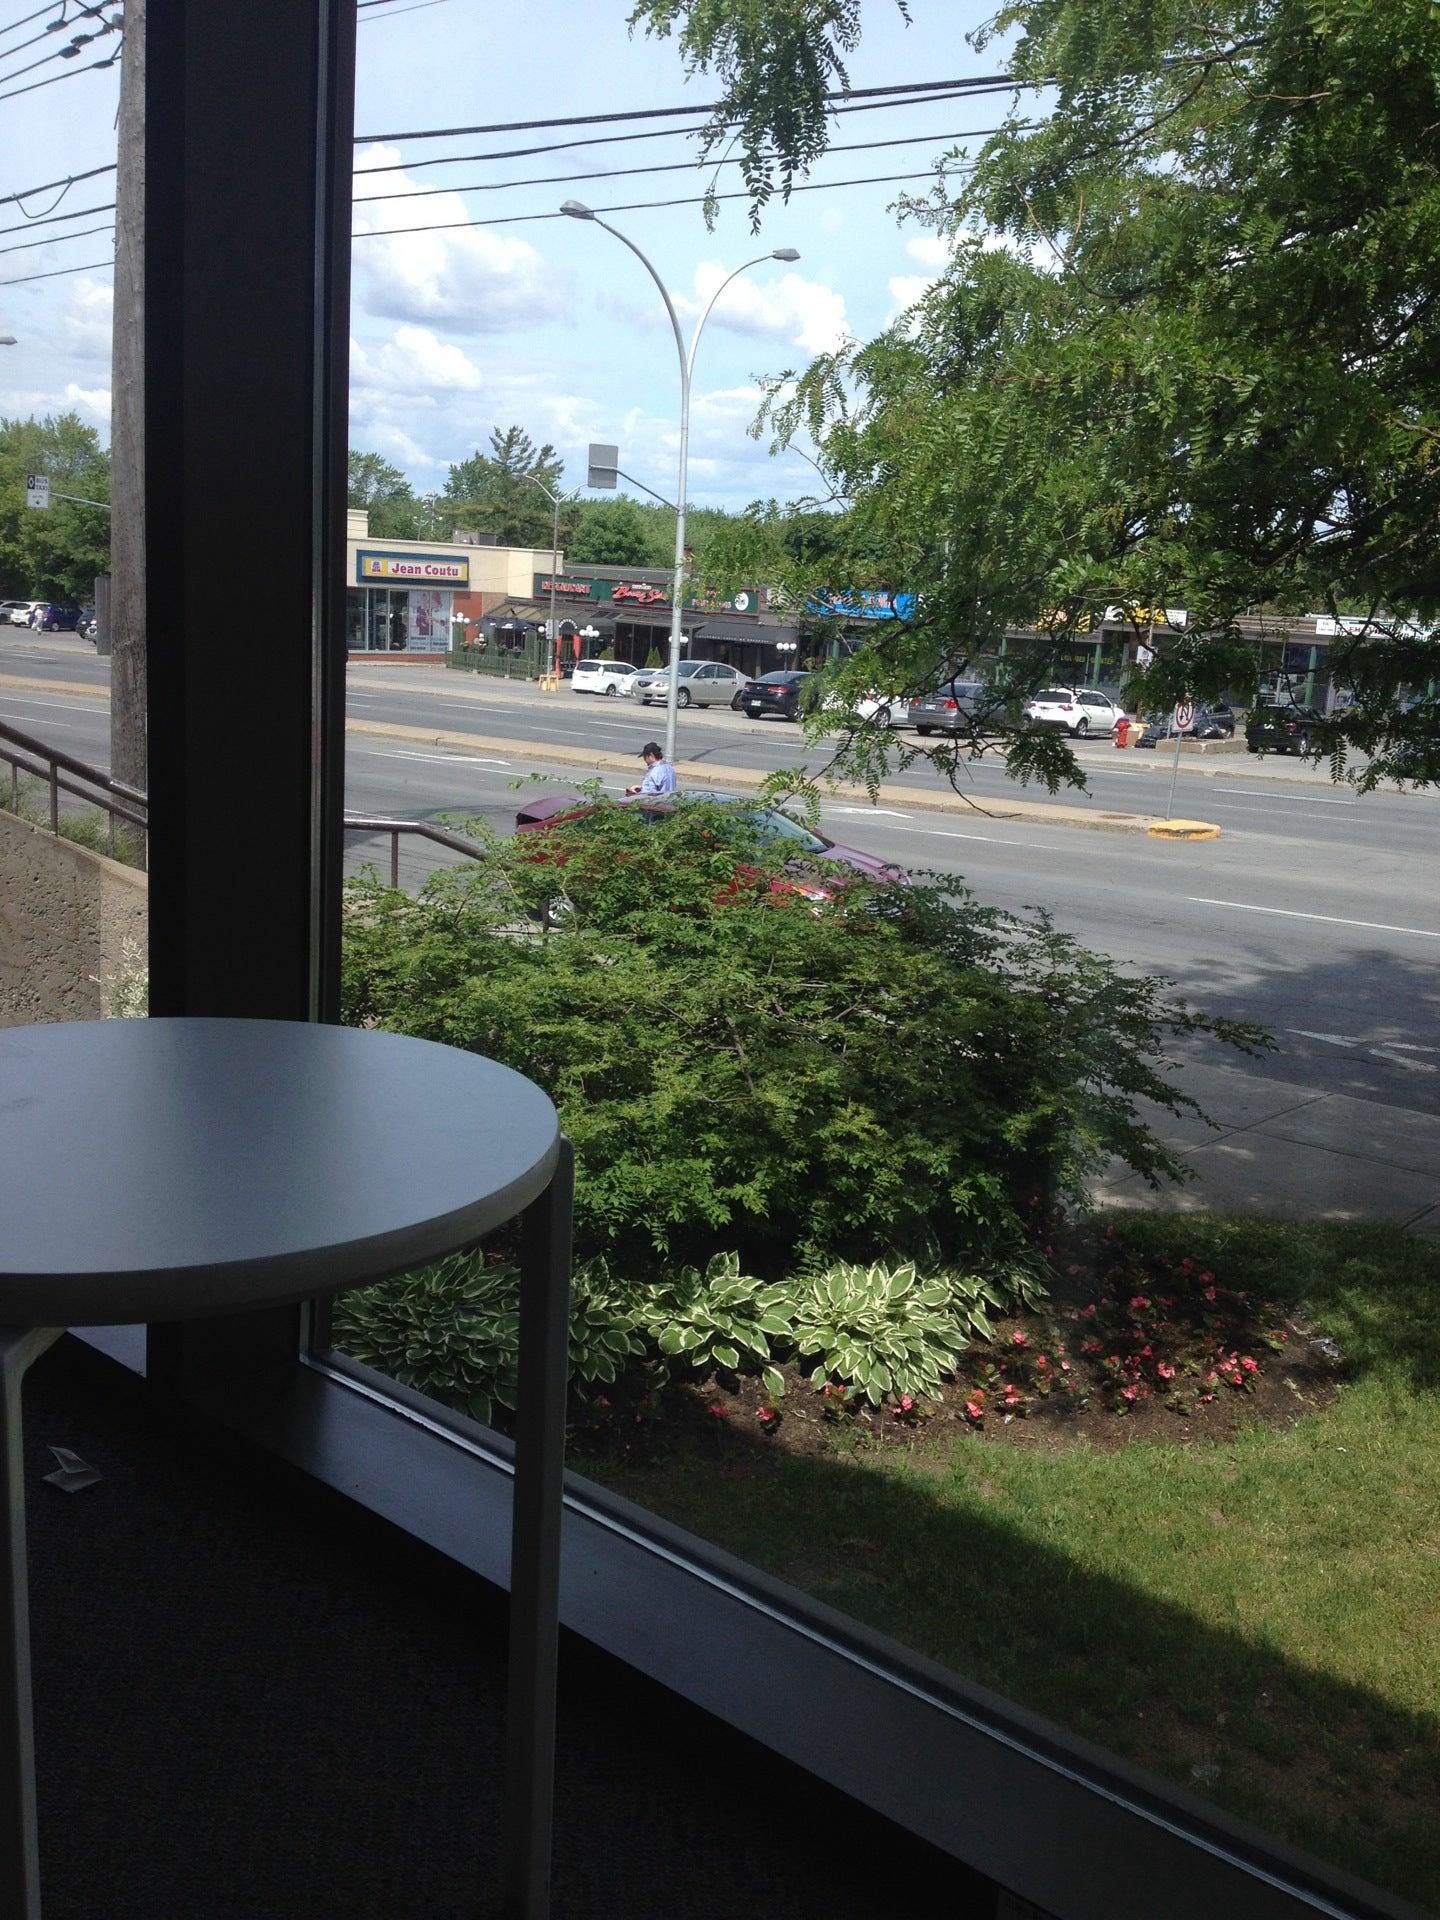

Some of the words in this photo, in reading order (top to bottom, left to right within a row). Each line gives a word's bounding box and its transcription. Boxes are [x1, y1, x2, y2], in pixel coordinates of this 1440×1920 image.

[392, 563, 421, 574] Jean
[425, 565, 459, 576] Coutu
[541, 581, 592, 594] RETAURANT
